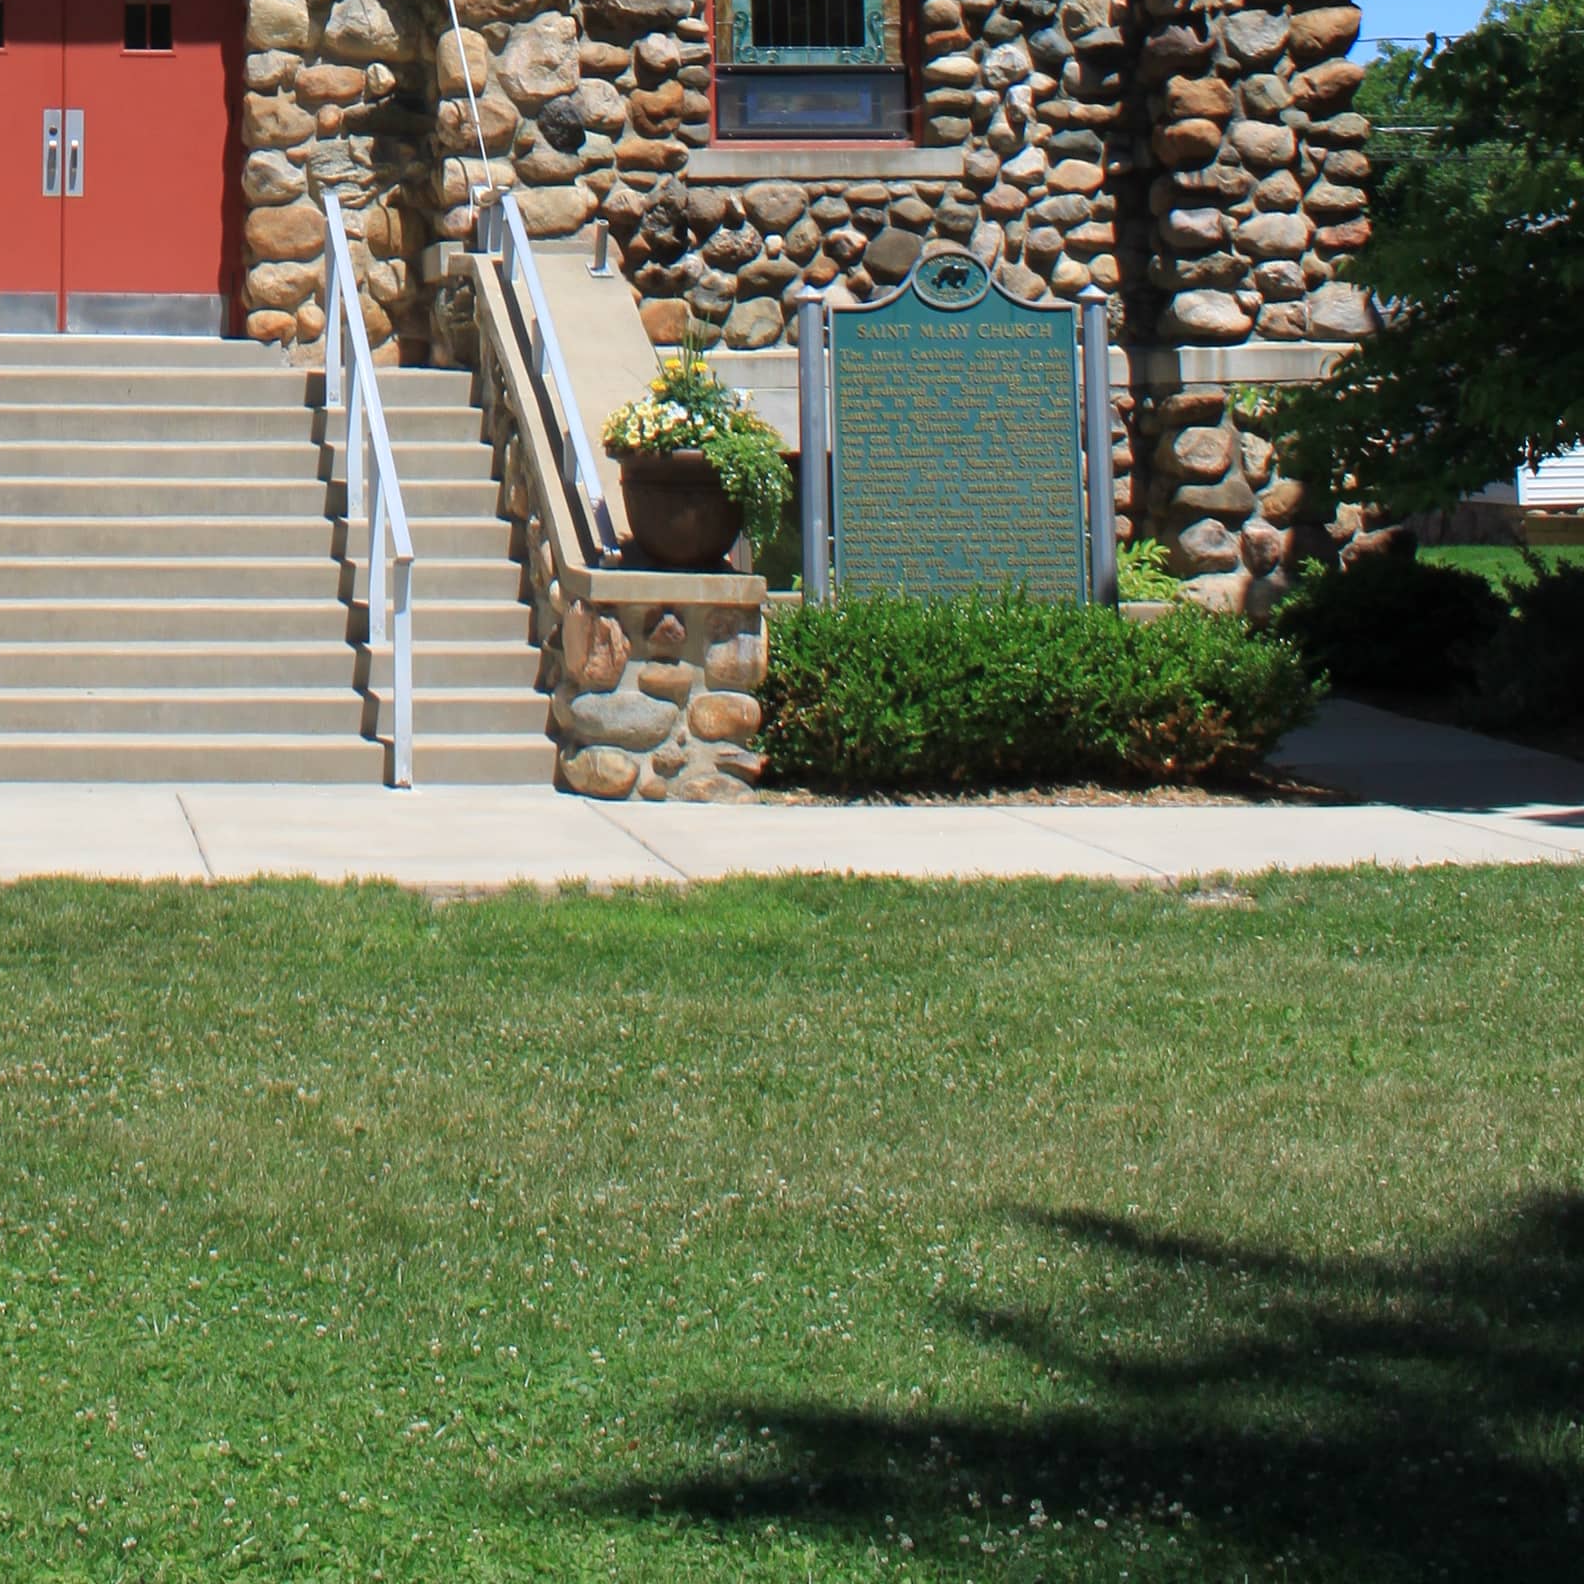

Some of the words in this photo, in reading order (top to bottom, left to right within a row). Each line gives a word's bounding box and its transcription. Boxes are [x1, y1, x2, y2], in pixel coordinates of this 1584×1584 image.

[857, 323, 911, 339] SAINT
[920, 323, 970, 339] MARY
[977, 323, 1052, 339] CHURCH
